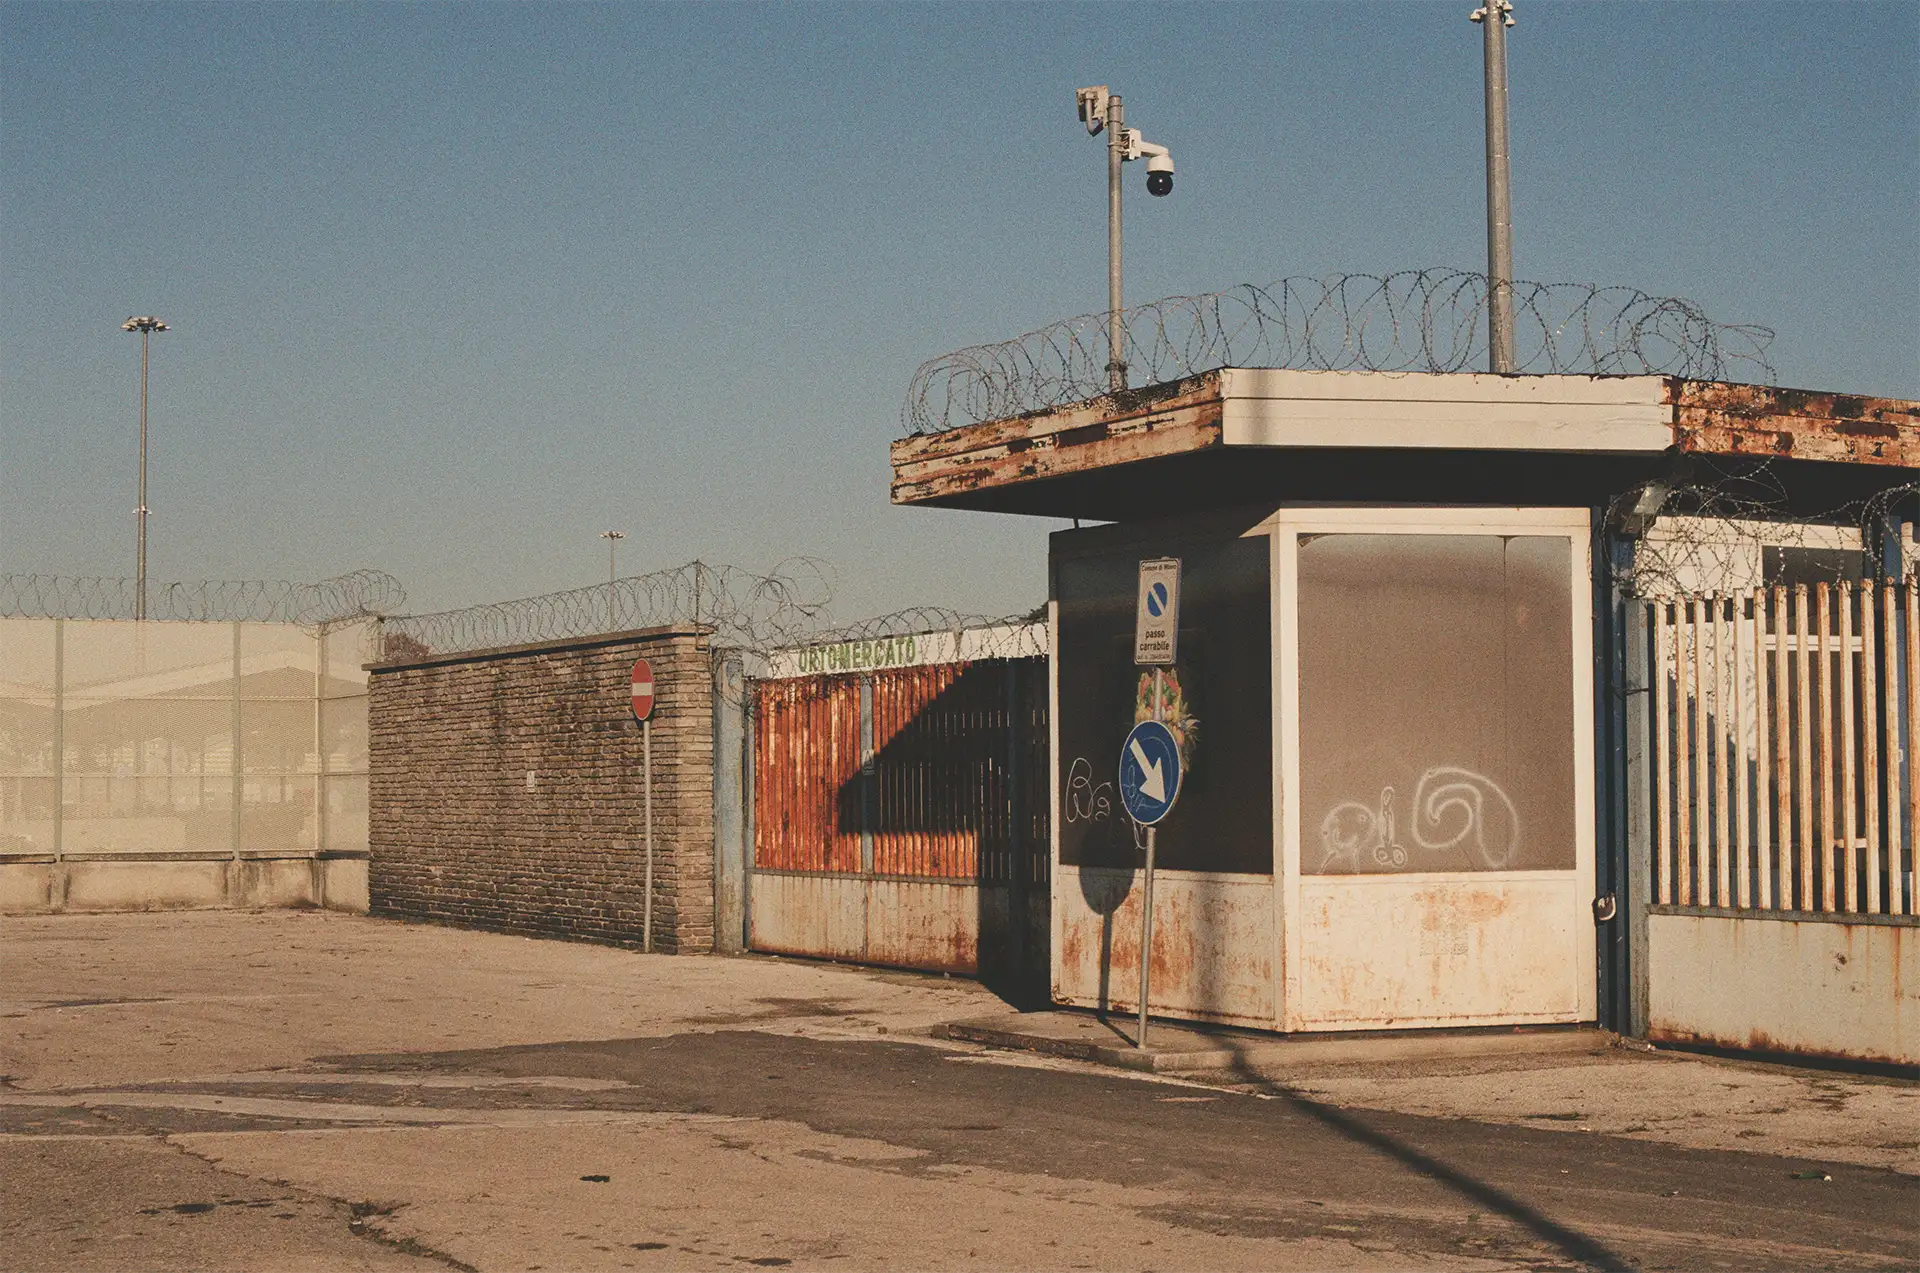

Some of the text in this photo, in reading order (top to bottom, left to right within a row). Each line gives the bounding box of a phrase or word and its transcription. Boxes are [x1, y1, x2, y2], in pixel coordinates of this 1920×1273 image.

[1145, 630, 1166, 640] passo
[1139, 641, 1170, 651] carrabile
[799, 636, 916, 672] ORTOMERCATO
